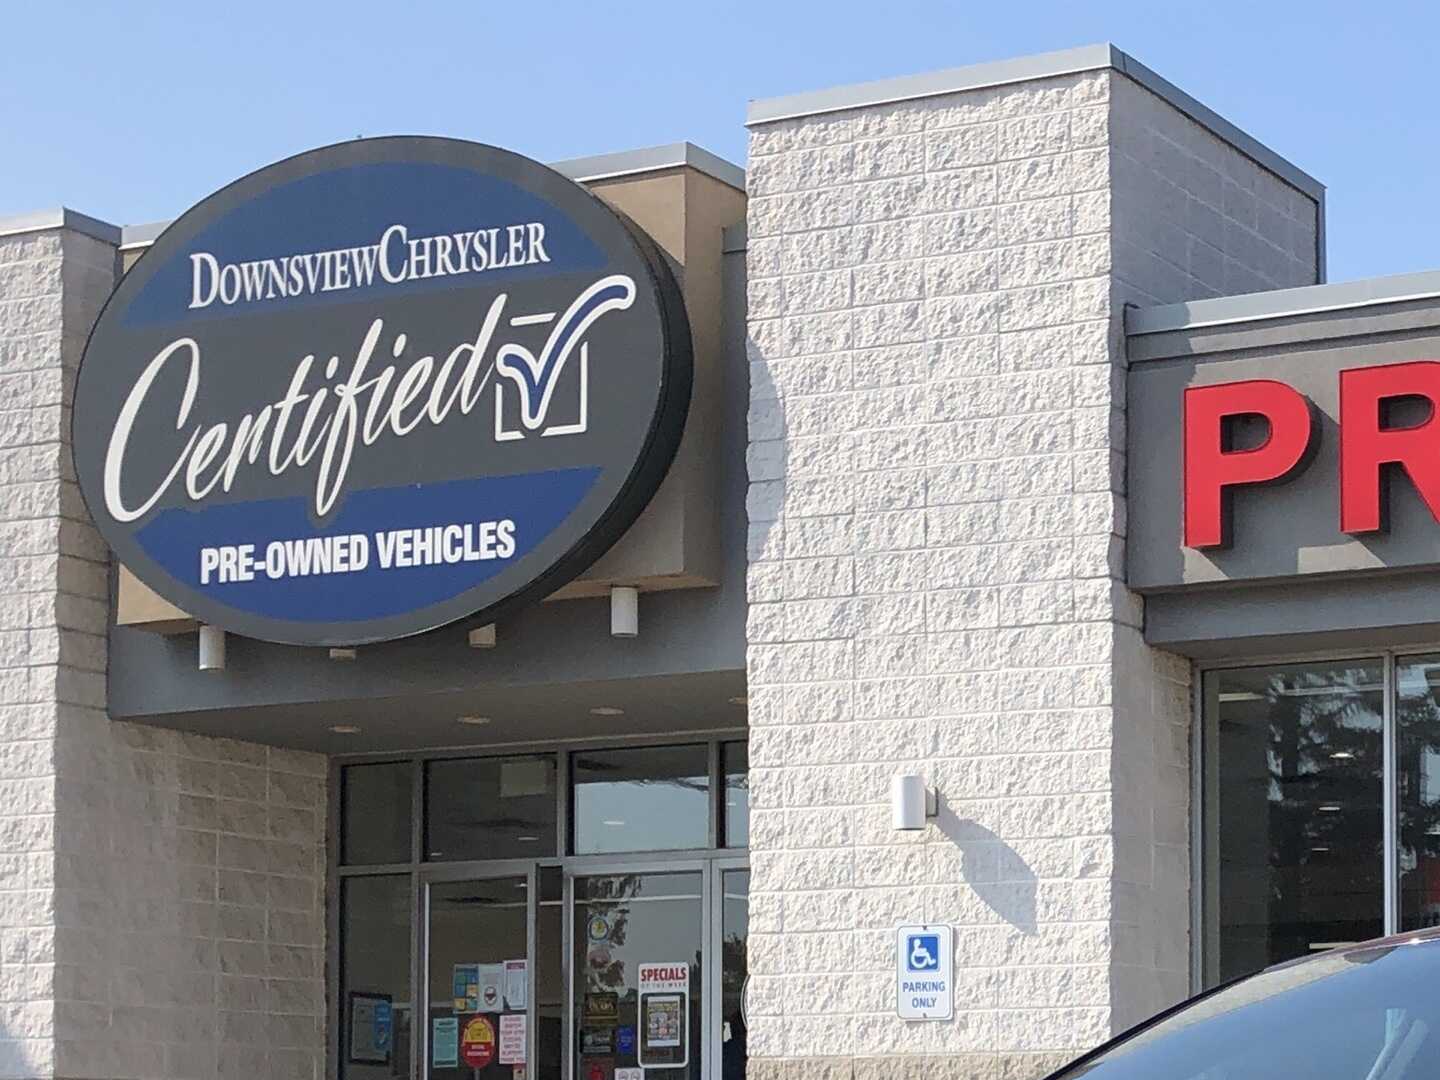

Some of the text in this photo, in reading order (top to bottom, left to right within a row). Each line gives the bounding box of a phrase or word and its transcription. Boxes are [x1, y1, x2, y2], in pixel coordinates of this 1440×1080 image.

[104, 294, 508, 523] Certified
[200, 519, 516, 585] PRE-OWNED VEHICLES
[641, 967, 687, 982] SPECIALS
[902, 981, 945, 992] PARKING
[912, 998, 937, 1008] ONLY
